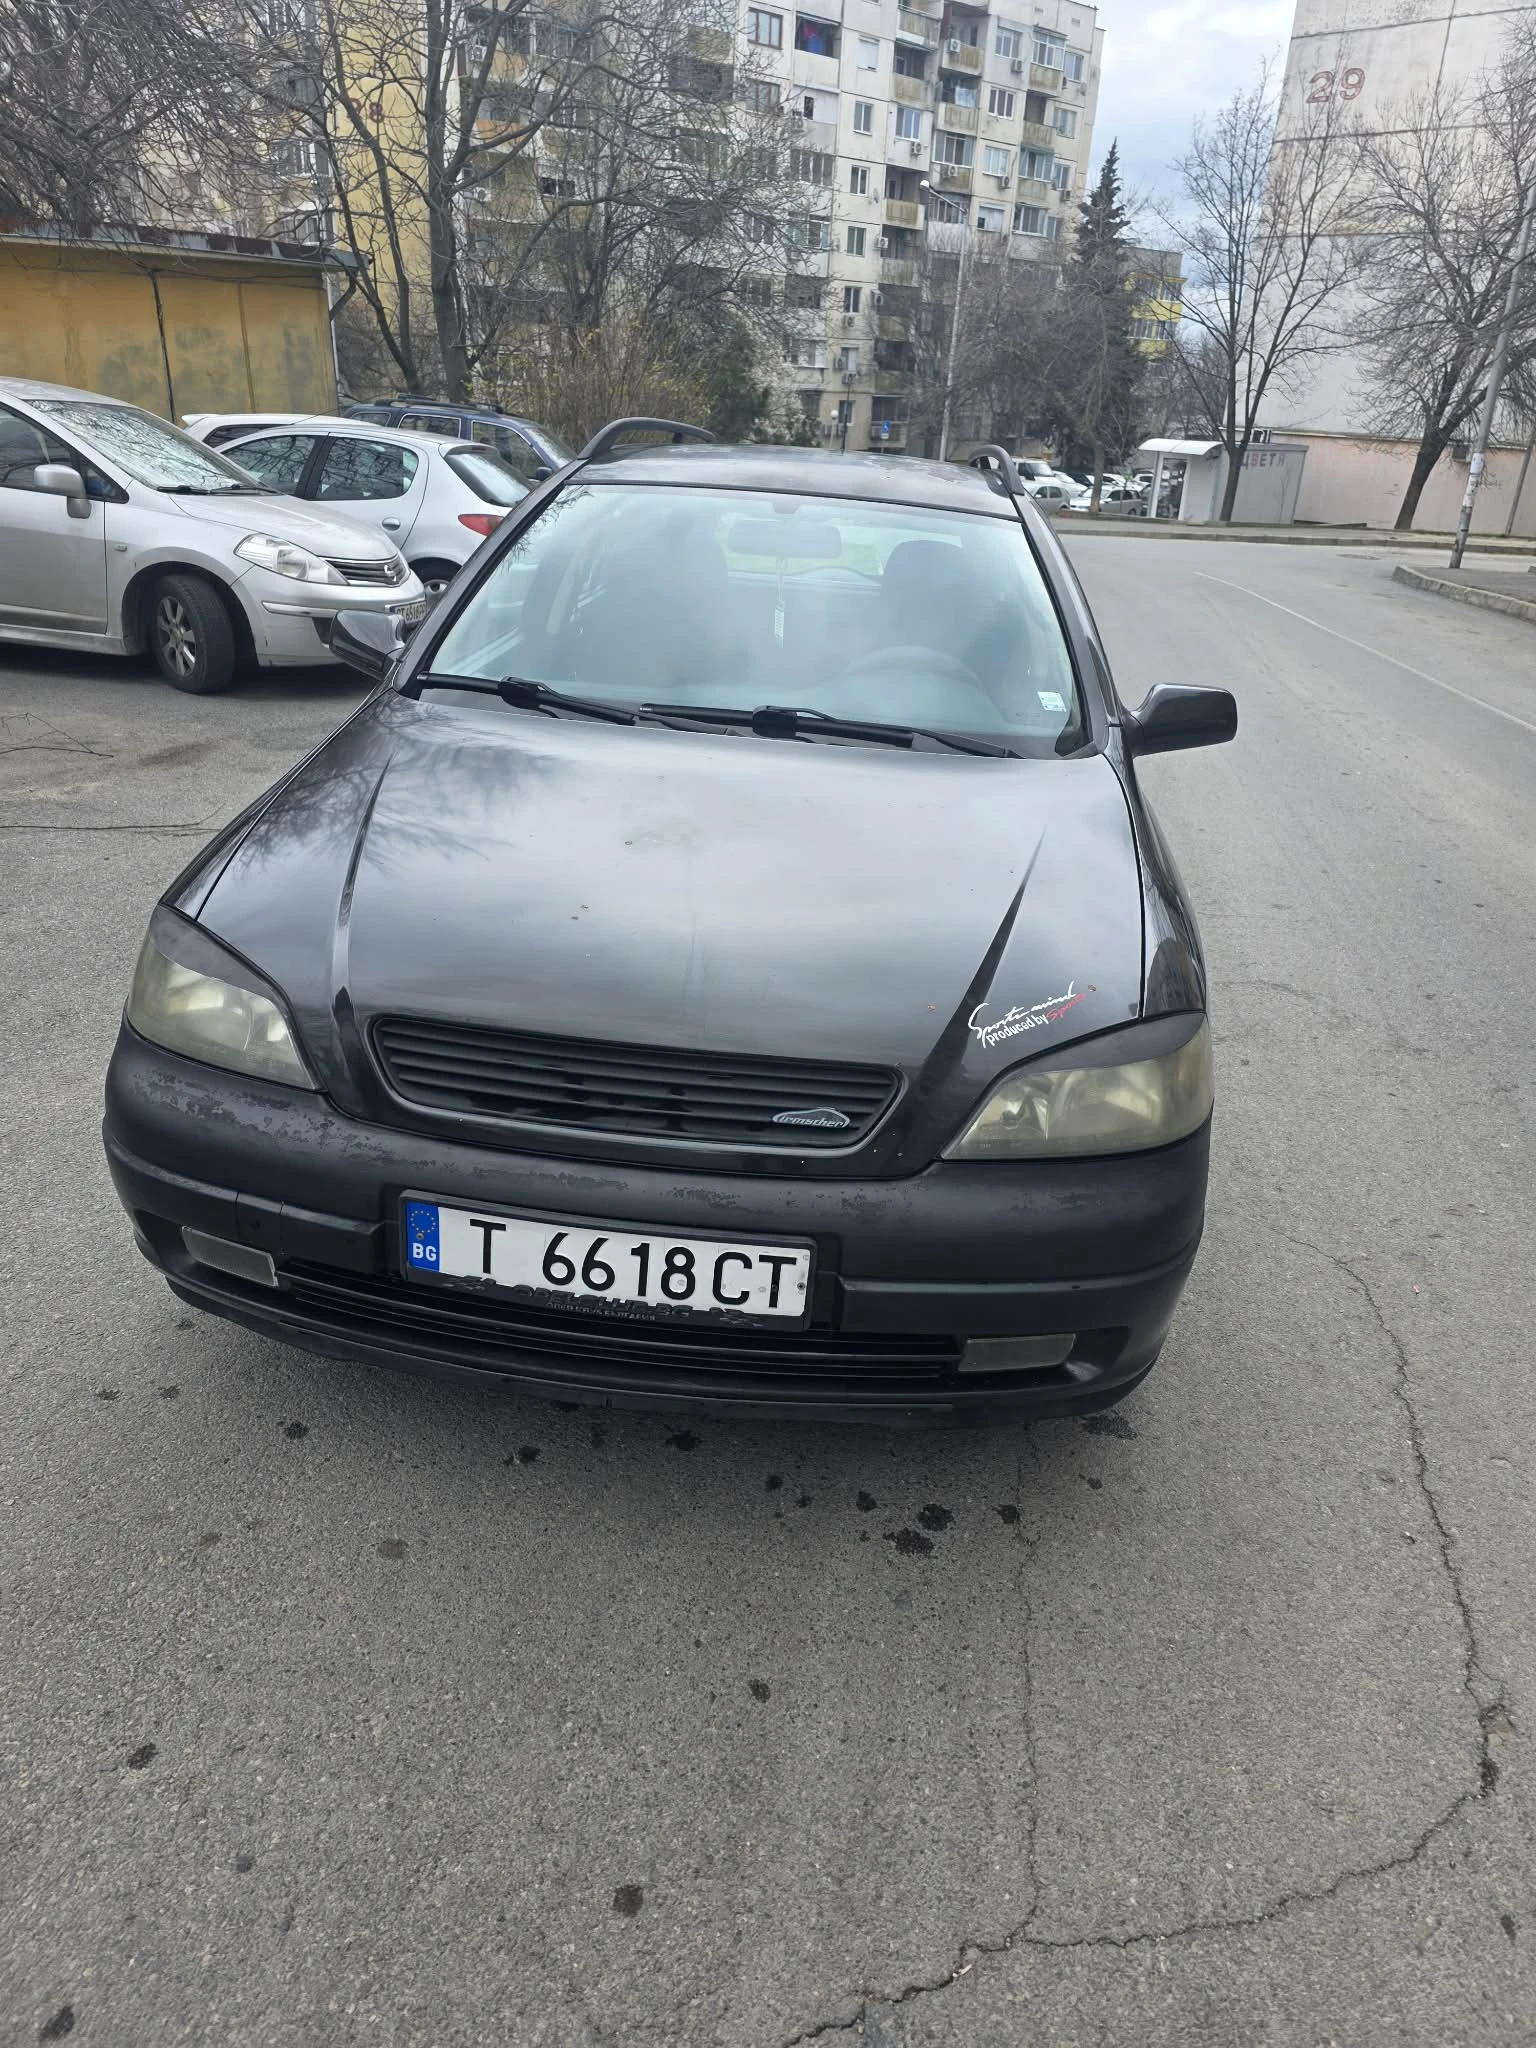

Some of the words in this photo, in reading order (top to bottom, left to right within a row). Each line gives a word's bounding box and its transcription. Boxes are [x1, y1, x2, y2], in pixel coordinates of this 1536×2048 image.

[1306, 68, 1365, 103] 29
[986, 1017, 1036, 1046] produced
[1035, 1013, 1049, 1026] by
[412, 1242, 437, 1262] BG
[470, 1218, 506, 1274] T
